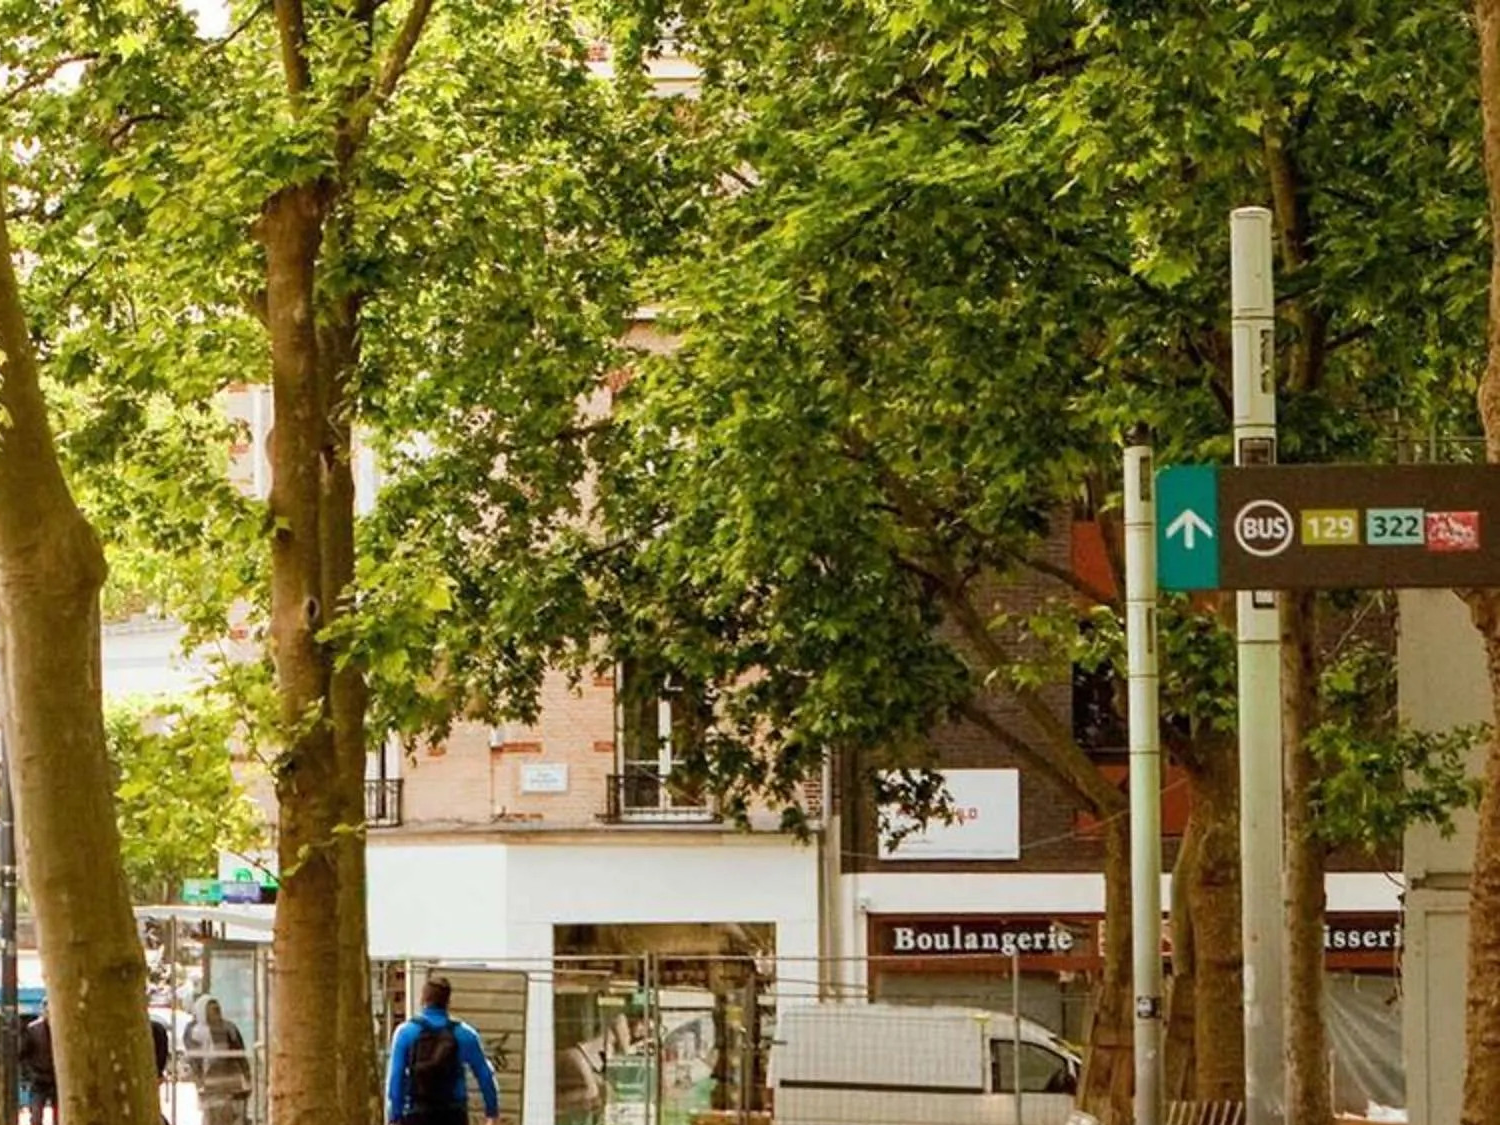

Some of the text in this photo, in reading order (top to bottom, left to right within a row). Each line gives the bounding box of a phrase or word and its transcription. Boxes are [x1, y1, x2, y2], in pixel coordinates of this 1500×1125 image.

[1244, 516, 1285, 539] BUS
[1307, 516, 1353, 539] 129
[1373, 515, 1419, 538] 322
[892, 924, 1401, 956] Boulangerie isseri
